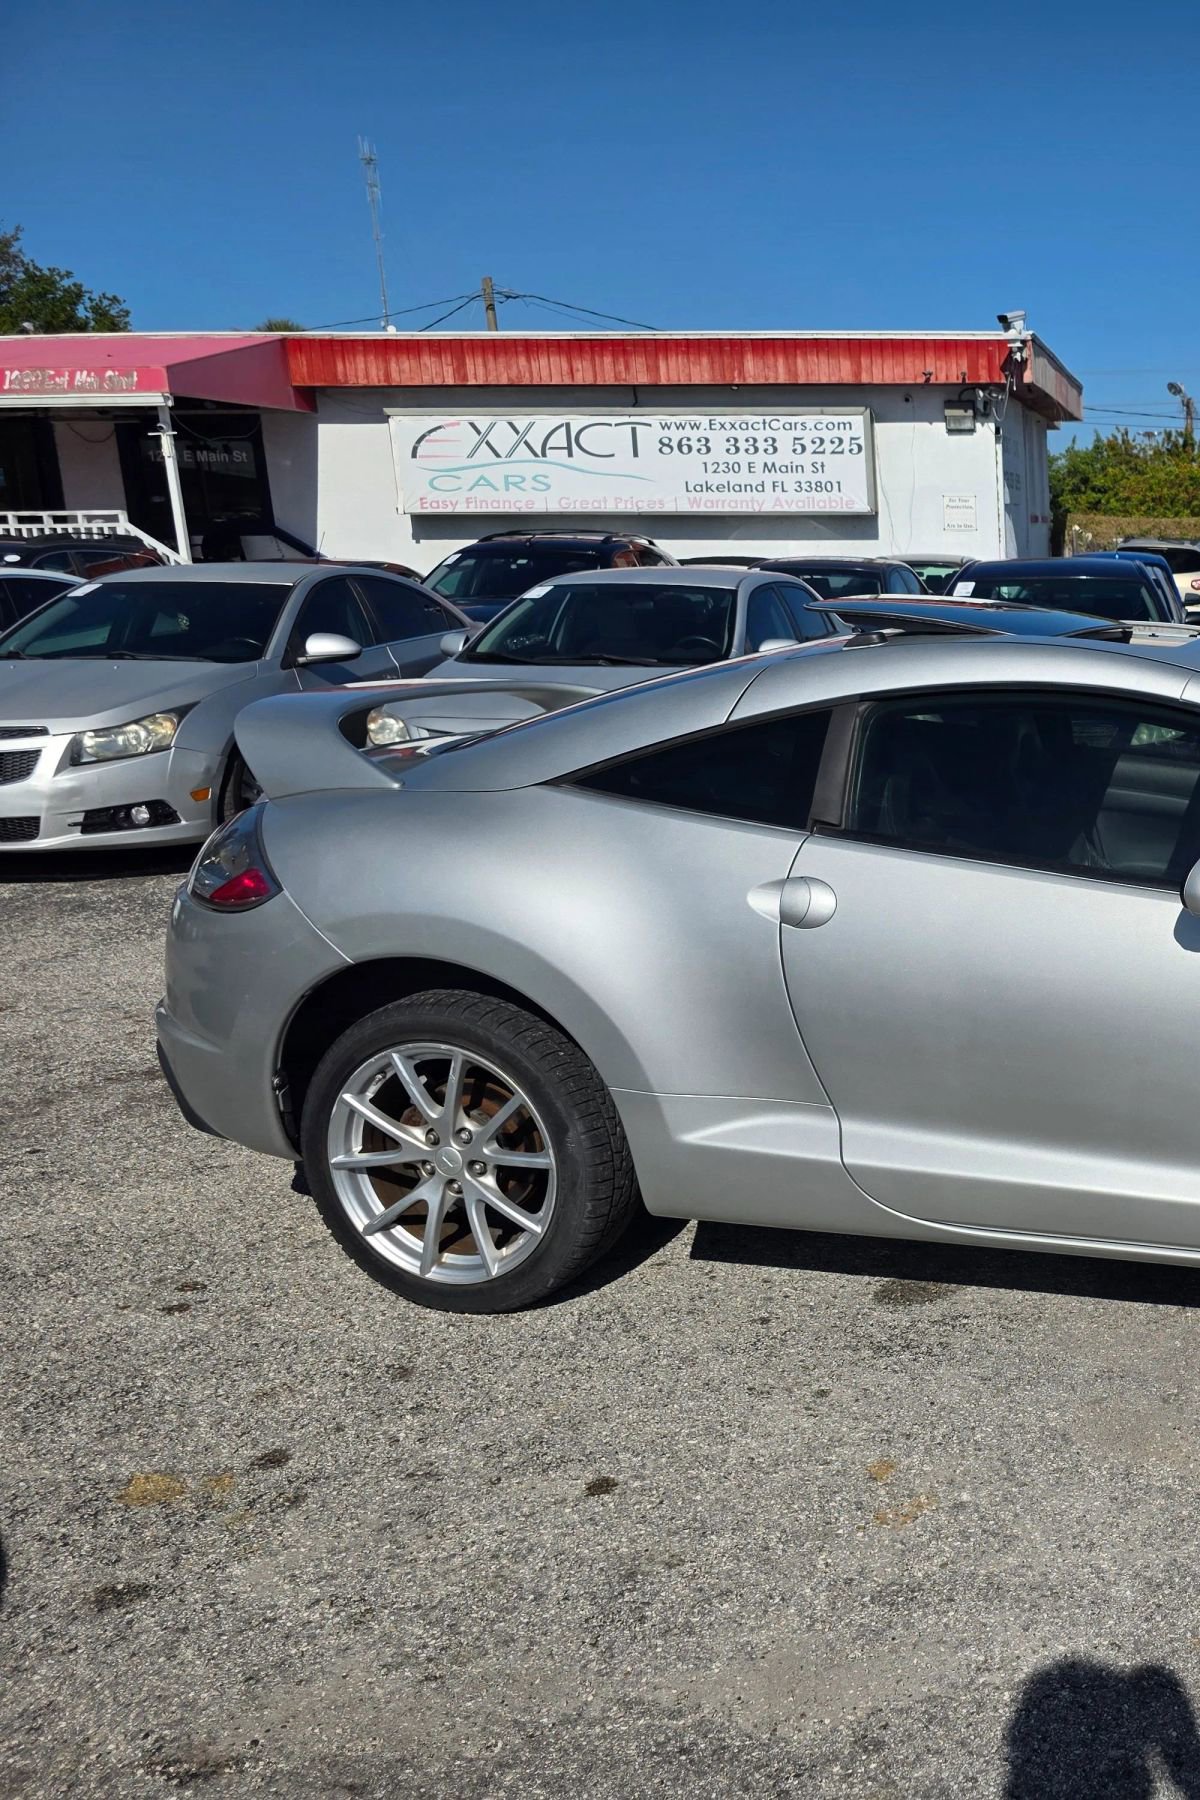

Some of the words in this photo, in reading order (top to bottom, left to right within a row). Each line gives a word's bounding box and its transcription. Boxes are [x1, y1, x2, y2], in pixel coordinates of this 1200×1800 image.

[659, 418, 853, 431] www.ExxactCars.com
[411, 421, 652, 459] EXXACT
[658, 436, 712, 455] 863
[725, 436, 778, 455] 333
[791, 436, 863, 455] 5225
[183, 450, 193, 462] E
[196, 450, 229, 463] Main
[232, 449, 248, 463] St
[702, 461, 741, 474] 1230
[748, 461, 756, 474] E
[762, 461, 805, 474] Main
[811, 461, 826, 474] St
[428, 474, 551, 492] CARS
[685, 480, 765, 493] Lakeland
[772, 480, 788, 493] FL
[794, 480, 842, 493] 33801
[419, 497, 459, 513] Easy
[465, 496, 535, 512] Finance
[558, 497, 608, 510] Great
[614, 496, 665, 512] Prices
[687, 497, 764, 512] Warranty
[771, 496, 856, 510] Available
